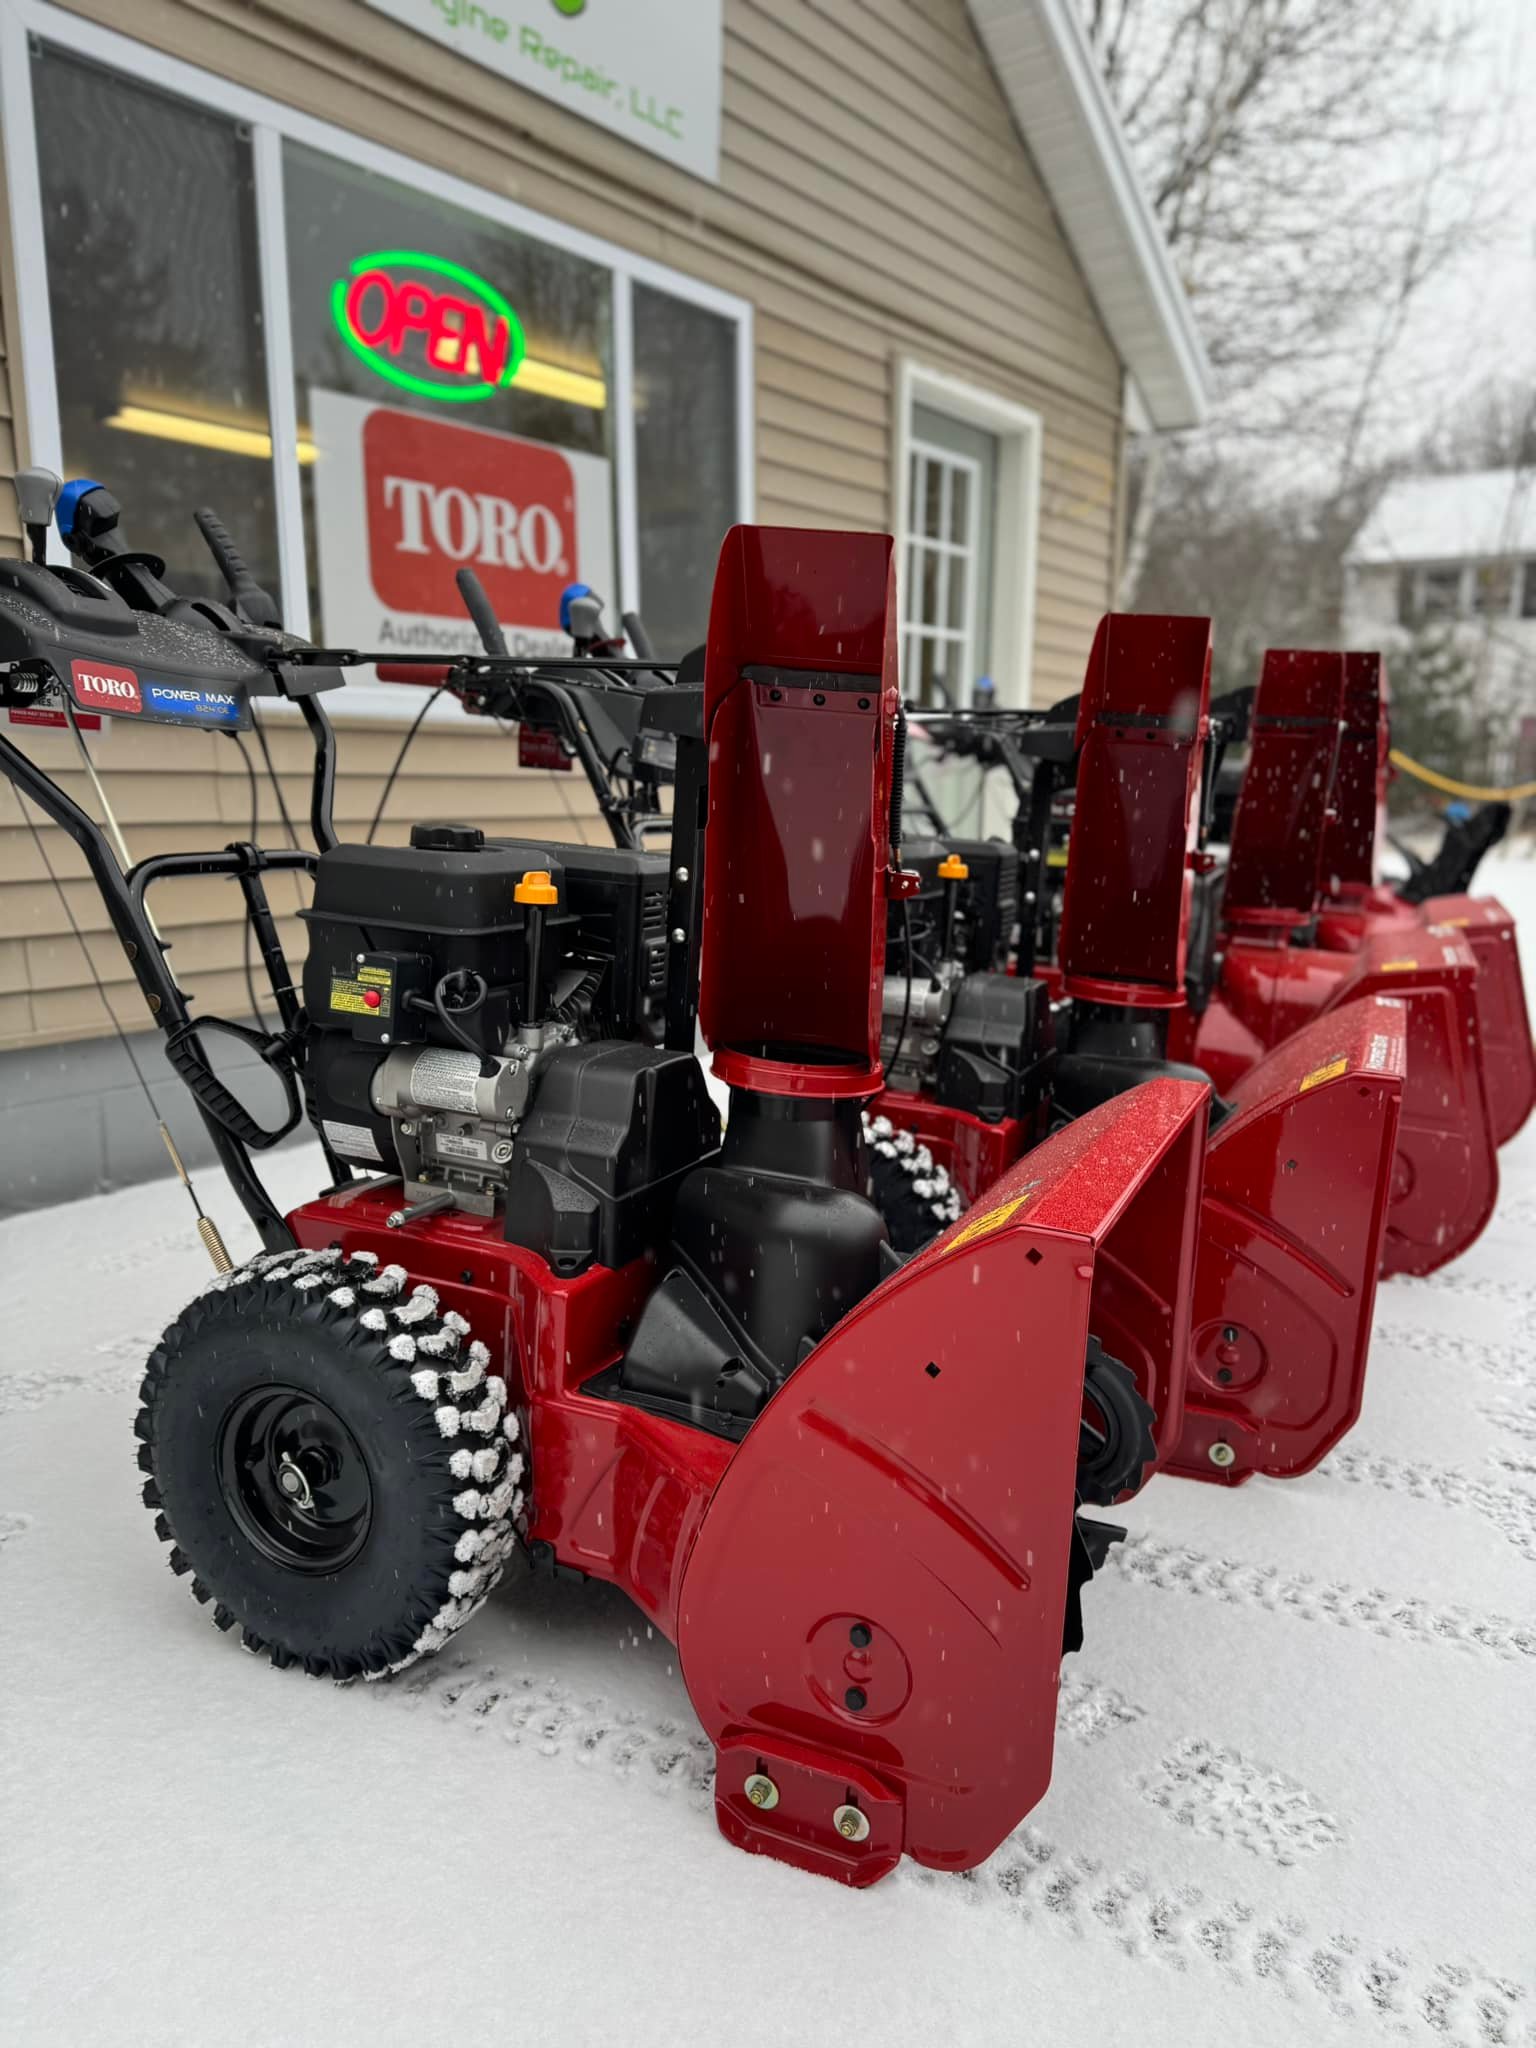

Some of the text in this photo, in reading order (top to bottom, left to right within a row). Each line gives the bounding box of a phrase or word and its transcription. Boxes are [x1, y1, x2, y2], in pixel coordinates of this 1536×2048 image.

[629, 86, 685, 141] LLC
[346, 269, 510, 385] OPEN
[513, 632, 573, 657] Deale
[77, 673, 137, 699] TORO
[152, 688, 234, 704] POWER MAX
